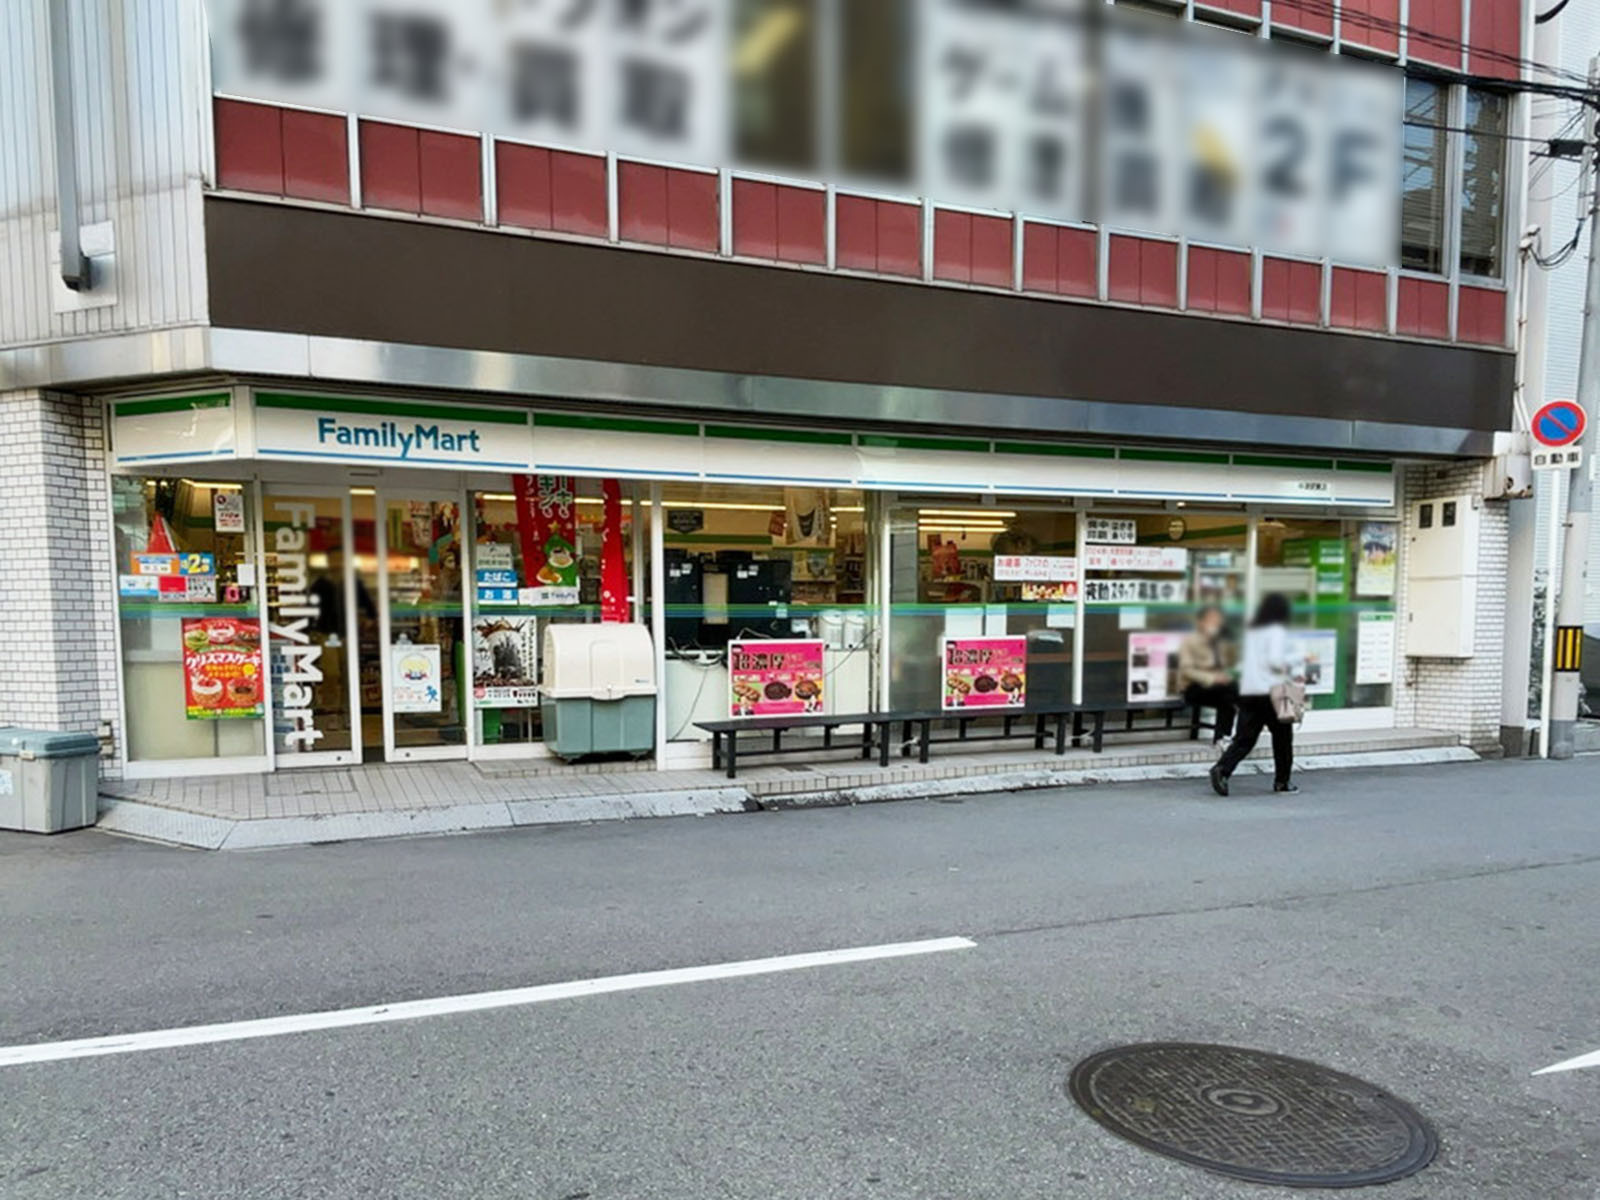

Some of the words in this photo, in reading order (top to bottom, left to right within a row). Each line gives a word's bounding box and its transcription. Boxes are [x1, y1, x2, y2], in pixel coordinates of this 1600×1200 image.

[317, 416, 481, 459] FamilyMart
[483, 571, 512, 583] たばこ
[271, 501, 325, 749] FamilyMart
[186, 651, 261, 668] クリスマスケーキ
